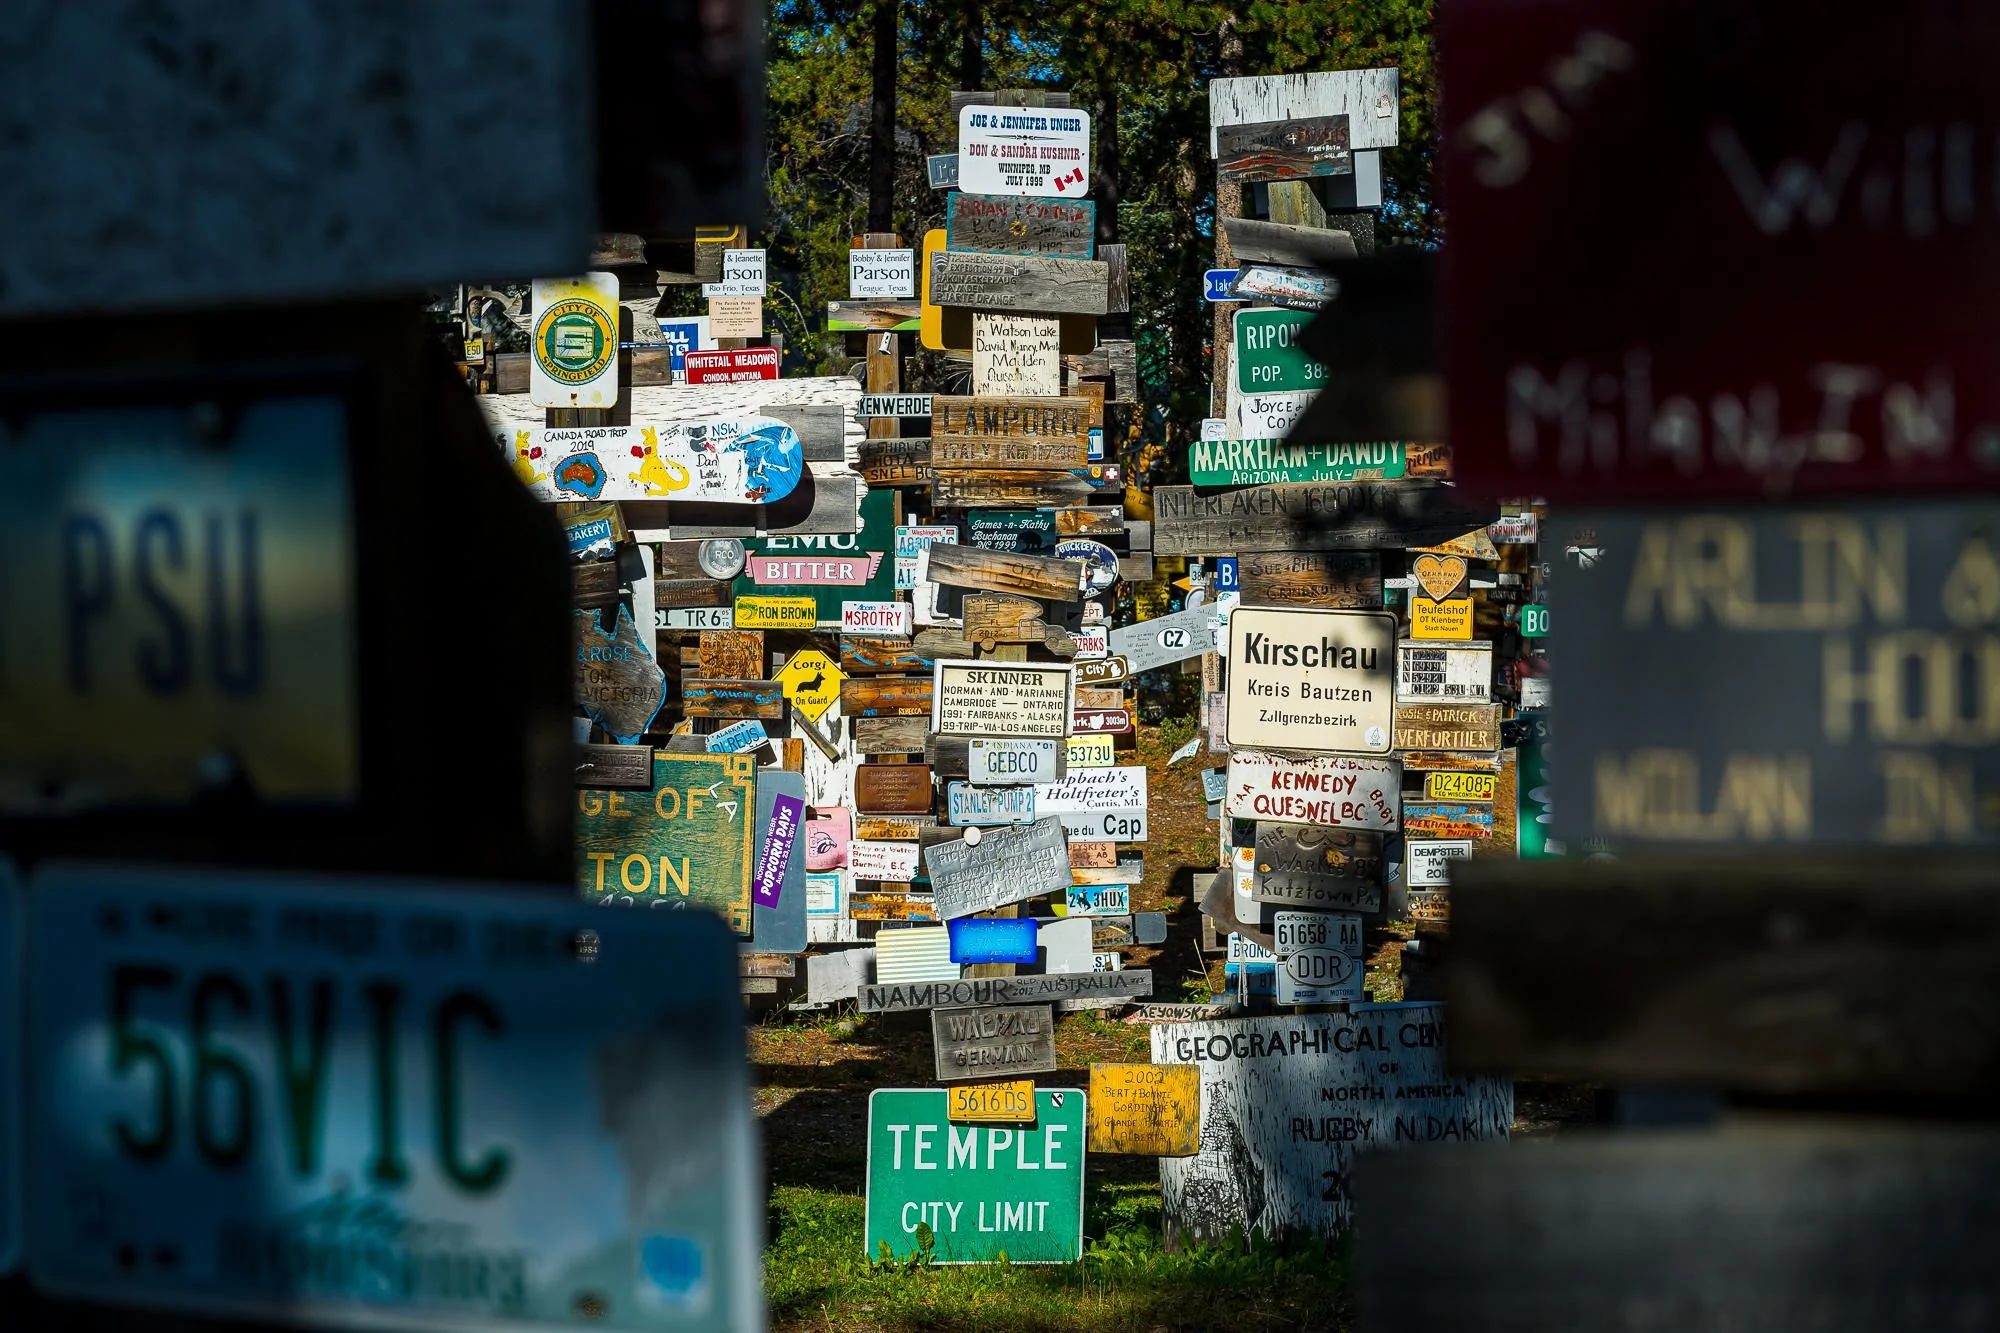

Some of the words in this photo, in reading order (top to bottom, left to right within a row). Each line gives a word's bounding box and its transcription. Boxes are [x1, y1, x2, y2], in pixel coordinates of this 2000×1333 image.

[970, 114, 988, 128] JOE
[990, 116, 998, 129] &
[1000, 115, 1048, 131] JENNIFER
[1050, 118, 1081, 132] UNGER
[969, 143, 988, 157] DON
[990, 145, 998, 158] &
[1000, 144, 1038, 159] SANDRA
[1040, 147, 1080, 161] KUSHNIR
[1039, 164, 1051, 175] MB
[1005, 175, 1023, 186] JULY
[1025, 176, 1043, 187] 1999
[735, 254, 763, 263] Jeanette
[852, 254, 875, 265] Bobby
[884, 254, 910, 263] Jennifer
[853, 265, 910, 280] Parson
[888, 284, 907, 292] Texas
[553, 304, 582, 317] CITY
[585, 307, 600, 318] OF
[990, 323, 1031, 337] Watson
[1034, 326, 1057, 337] Lake
[542, 356, 605, 380] SPRINGFIELD
[688, 356, 731, 369] WHITETAIL
[735, 354, 776, 366] MEADOWS
[732, 371, 762, 381] MONTANA
[1252, 366, 1283, 383] POP.
[1251, 398, 1292, 414] JOYCE
[544, 430, 582, 443] CANADA
[584, 429, 607, 440] ROAD
[607, 428, 628, 439] TRIP
[570, 441, 595, 453] 2019
[568, 523, 605, 542] BAKERY
[972, 519, 1002, 531] James
[1019, 520, 1050, 531] Kathy
[1491, 525, 1534, 537] FARMINGTON
[972, 531, 1018, 541] Buchanan
[995, 541, 1017, 550] 1999
[1059, 542, 1101, 554] BUCKLEY'S
[766, 562, 855, 580] BITTER
[758, 606, 778, 619] RON
[781, 607, 815, 620] BROWN
[1417, 604, 1468, 615] Teufelshof
[685, 610, 707, 626] TR
[711, 610, 721, 626] 6
[846, 612, 902, 627] MSROTRY
[1432, 616, 1464, 625] Kienberg
[1163, 630, 1184, 648] CZ
[590, 646, 631, 662] ROSE
[1245, 632, 1377, 671] Kirschau
[793, 661, 826, 671] Corgi
[1086, 664, 1106, 675] City
[966, 671, 1043, 687] SKINNER
[585, 686, 658, 703] VICTORIA
[944, 686, 983, 696] NORMAN
[990, 687, 1009, 697] AND
[1016, 688, 1064, 699] MARIANNE
[1248, 679, 1290, 698] Kreis
[1300, 681, 1372, 702] Bautzen
[796, 697, 806, 705] On
[807, 696, 828, 705] Guard
[943, 698, 997, 708] CAMBRIDGE
[1023, 699, 1063, 710] ONTARIO
[899, 708, 923, 716] REBECCA
[967, 710, 1018, 721] FAIRBANKS
[1027, 711, 1063, 722] ALASKA
[1432, 709, 1478, 724] PATRICK
[992, 741, 1032, 750] INDIANA
[988, 752, 1037, 774] GEBCO
[1271, 770, 1357, 796] KENNEDY
[1047, 785, 1140, 803] Holtfreter's
[655, 786, 711, 820] OF
[953, 792, 993, 814] STANLEY
[997, 792, 1025, 813] PUMP
[1086, 799, 1121, 808] Curtis,
[1254, 794, 1341, 825] QUESNEL
[788, 823, 796, 838] 2014
[1081, 825, 1095, 836] du
[1103, 814, 1141, 840] Cap
[1260, 827, 1288, 849] THE
[756, 860, 767, 881] NORTH
[762, 838, 774, 859] LOUP,
[768, 816, 778, 838] NEBR.
[761, 838, 785, 897] POPCORN
[776, 805, 793, 838] DAYS
[1414, 847, 1465, 857] DEMPSTER
[586, 852, 690, 897] TON
[1069, 893, 1076, 908] 2
[1093, 891, 1124, 908] 3HUX
[1279, 924, 1326, 945] 61658
[1340, 924, 1359, 945] AA
[1298, 955, 1342, 979] DDR
[867, 978, 1011, 1010] NAMBOUR
[1038, 974, 1130, 994] AUSTRALIA
[1012, 986, 1034, 997] 2012
[1176, 1024, 1389, 1063] GEOGRAPHICAL
[1379, 1063, 1399, 1075] OF
[1124, 1071, 1165, 1084] 2002
[1104, 1087, 1130, 1098] BERT
[1321, 1086, 1384, 1102] NORTH
[1395, 1084, 1466, 1100] AMERICA
[957, 1090, 1000, 1112] 5616
[1005, 1090, 1028, 1113] DS
[887, 1125, 1067, 1170] TEMPLE
[901, 1201, 963, 1234] CITY
[979, 1201, 1050, 1233] LIMIT
